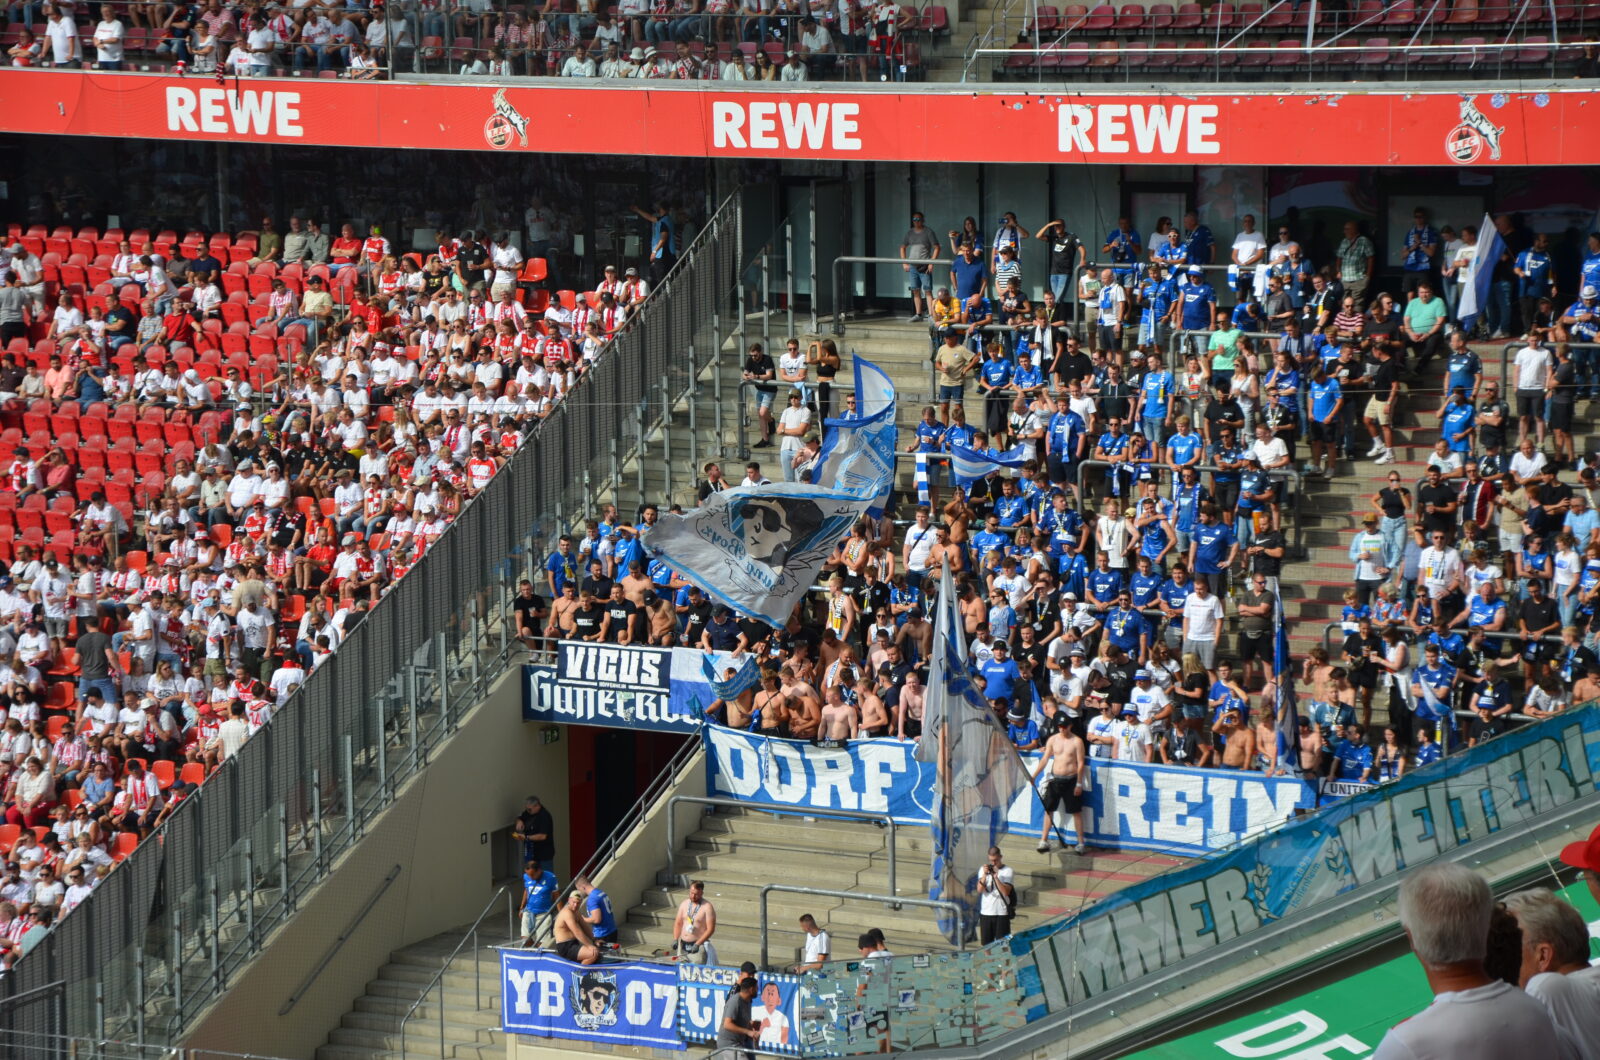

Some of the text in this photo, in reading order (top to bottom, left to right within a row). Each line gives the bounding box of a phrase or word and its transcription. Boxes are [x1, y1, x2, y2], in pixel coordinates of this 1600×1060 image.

[165, 86, 304, 137] REWE
[713, 101, 862, 150] REWE
[1058, 103, 1221, 154] REWE
[565, 645, 663, 686] VICUS
[713, 734, 907, 809] DORF
[1338, 722, 1596, 884] WEITER!
[1031, 866, 1260, 1015] IMMER
[508, 968, 678, 1029] YB 07
